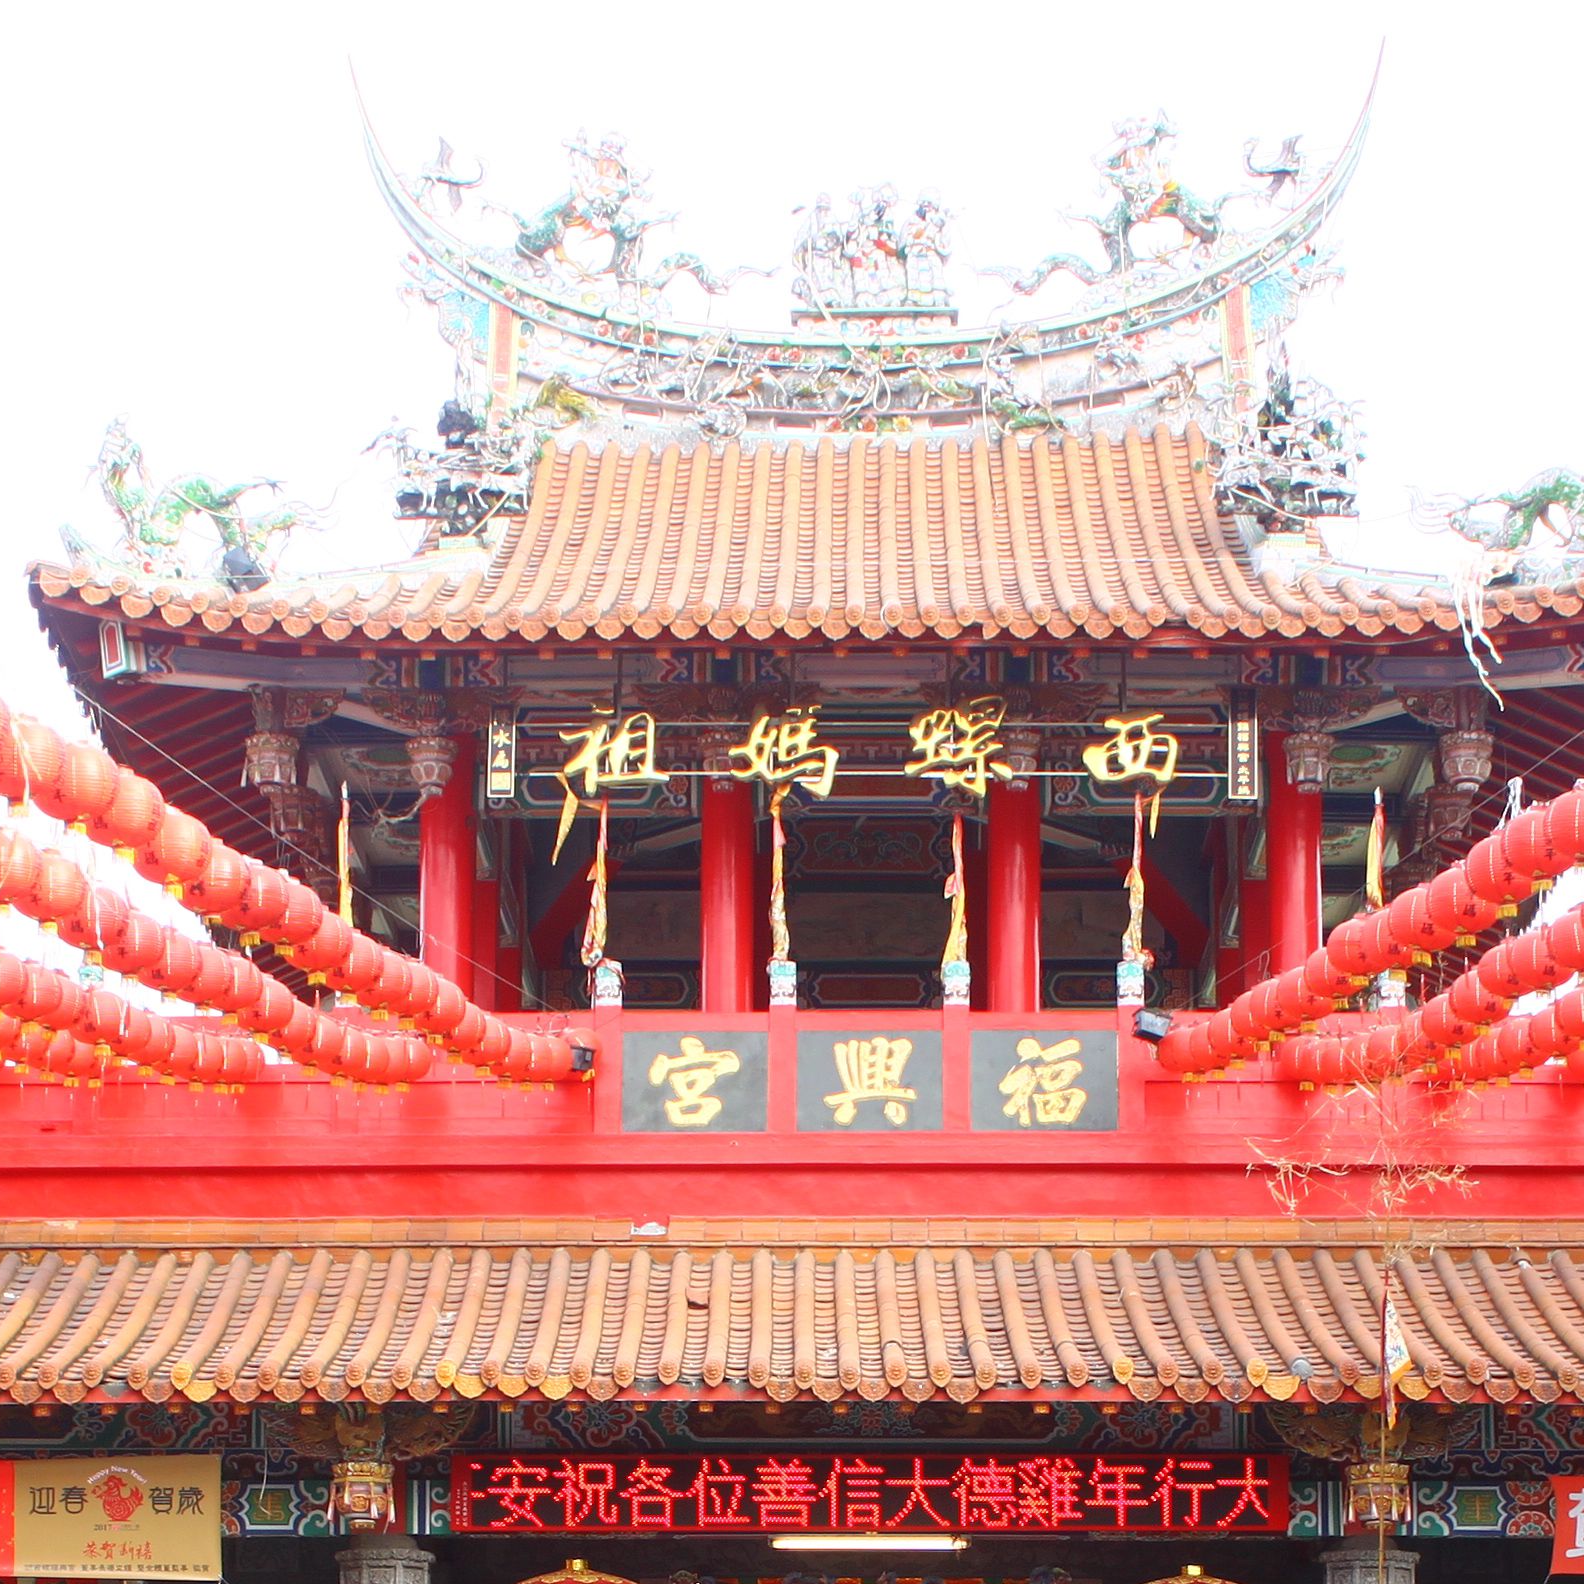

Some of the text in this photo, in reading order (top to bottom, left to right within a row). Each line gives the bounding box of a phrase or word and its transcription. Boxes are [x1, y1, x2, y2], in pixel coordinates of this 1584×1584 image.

[647, 1037, 1088, 1126] 福興宮
[29, 1485, 206, 1515] 迎春 賀歲
[470, 1457, 1270, 1528] 安祝各位善信大德雞年行大
